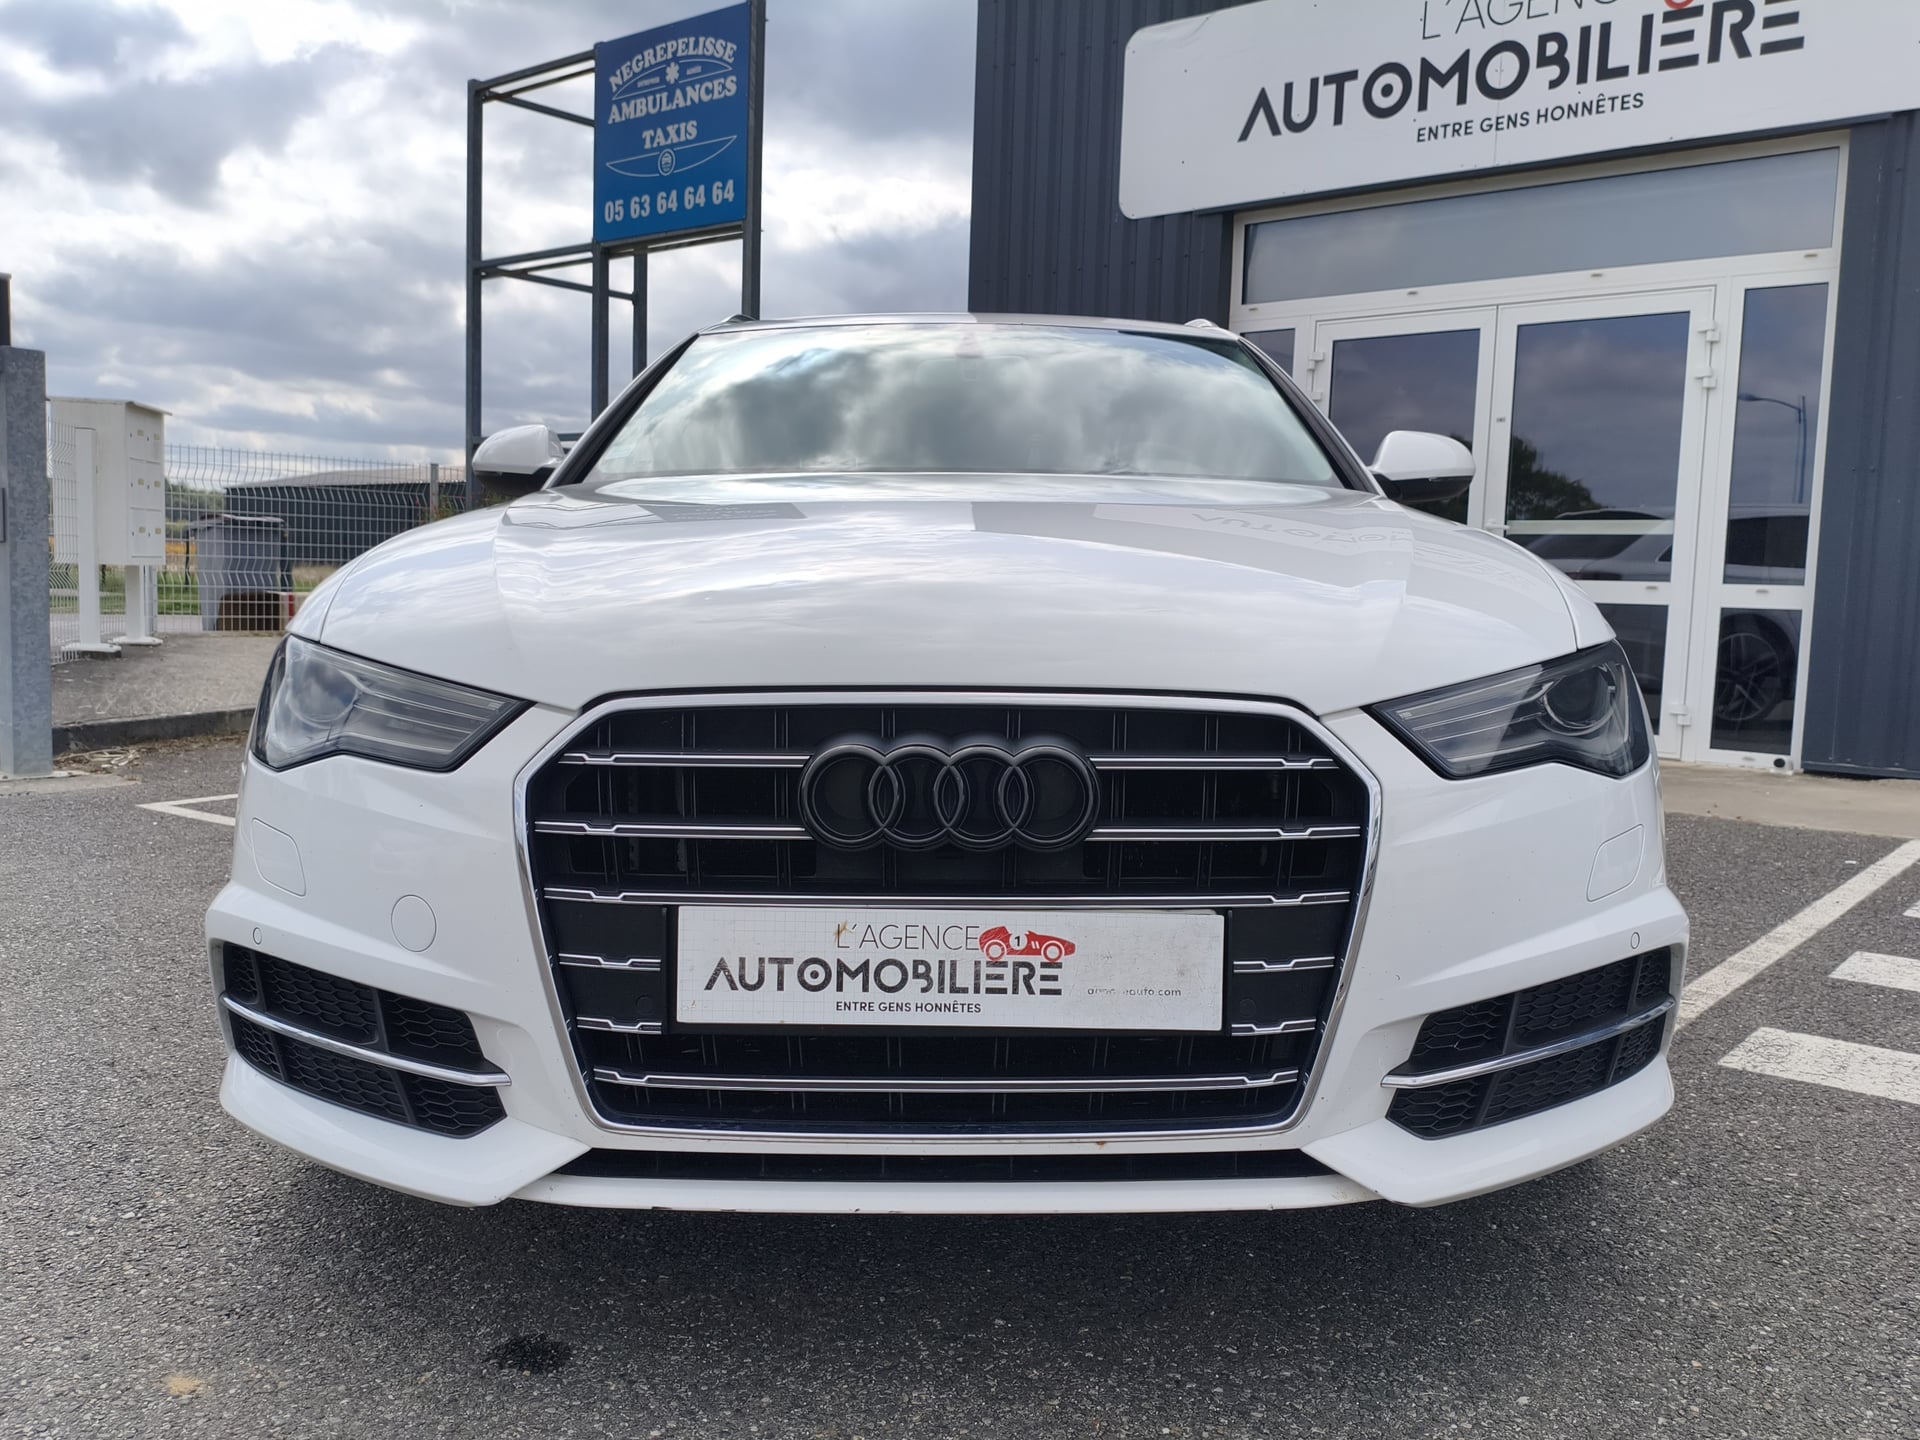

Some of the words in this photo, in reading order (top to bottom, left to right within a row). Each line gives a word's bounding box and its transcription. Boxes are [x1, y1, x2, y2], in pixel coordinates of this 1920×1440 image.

[609, 36, 738, 93] NEGREPELISSE
[608, 76, 738, 124] AMBULANCES
[1416, 120, 1474, 143] ENTRE
[1479, 112, 1530, 133] GENS
[1536, 92, 1644, 125] HONNÊTES
[642, 120, 698, 150] TAXIS
[605, 201, 624, 223] 05
[630, 195, 650, 219] 63
[656, 190, 678, 215] 64
[684, 185, 706, 210] 64
[712, 179, 735, 205] 64
[836, 923, 980, 951] L'AGENCE
[1014, 935, 1021, 947] 1
[836, 1001, 875, 1013] ENTRE
[878, 1002, 912, 1013] GENS
[915, 1000, 982, 1014] HONNÊTES
